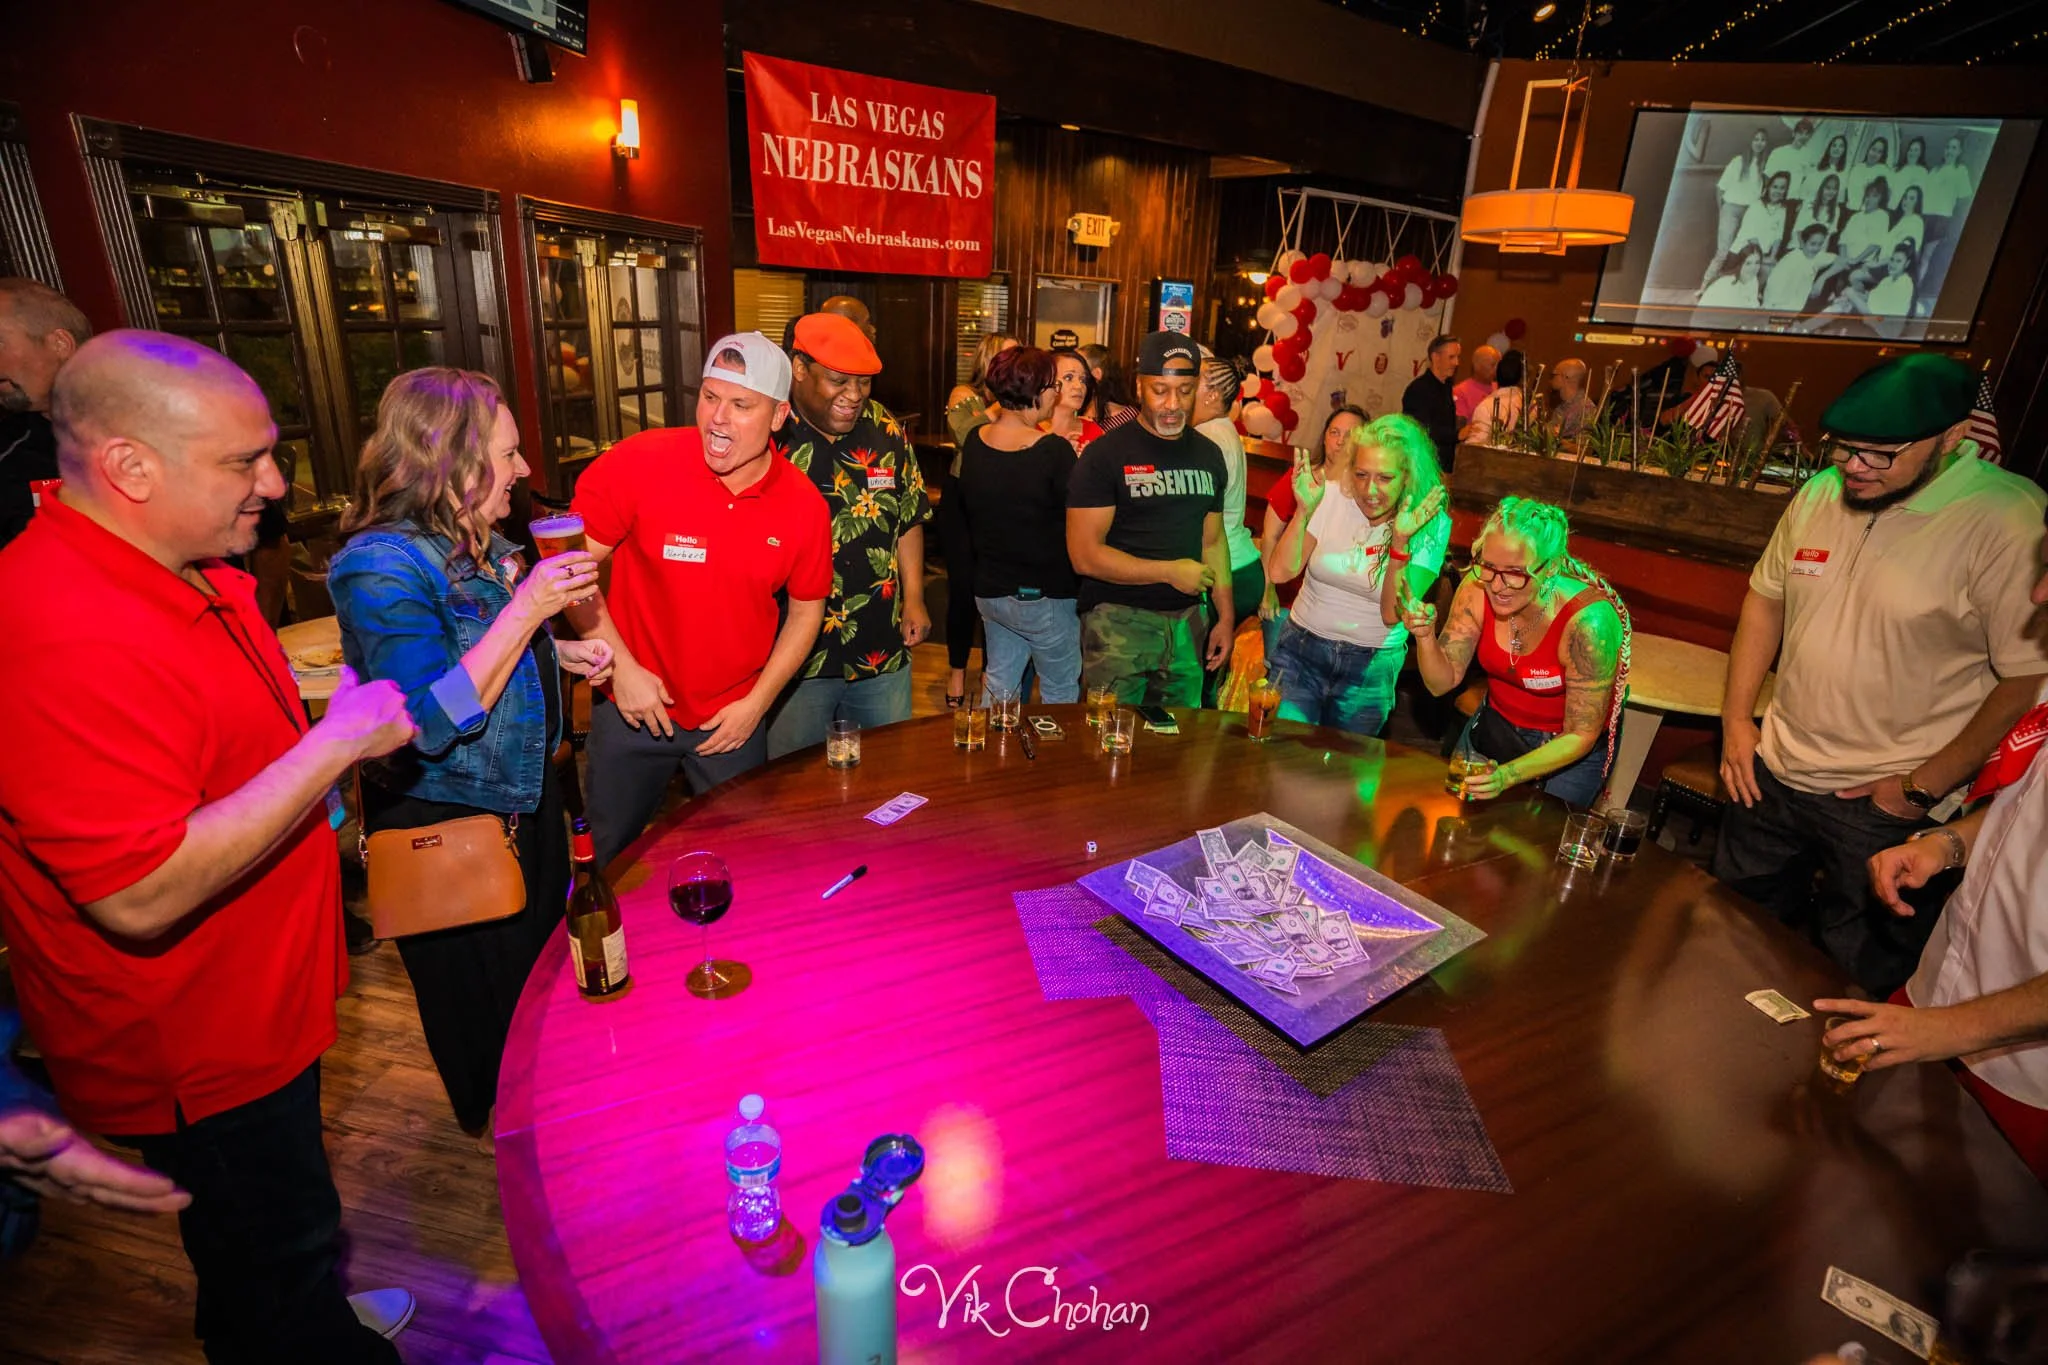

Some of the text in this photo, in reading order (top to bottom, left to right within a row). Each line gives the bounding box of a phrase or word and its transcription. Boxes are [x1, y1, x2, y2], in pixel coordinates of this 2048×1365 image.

[810, 91, 945, 140] LAS VEGAS
[761, 132, 983, 199] NEBRASKANS
[767, 217, 981, 251] LasVegasNebraskans.com
[1086, 216, 1106, 237] EXIT
[675, 535, 698, 545] Hello
[1801, 549, 1820, 559] Hello
[1530, 668, 1550, 677] Hello
